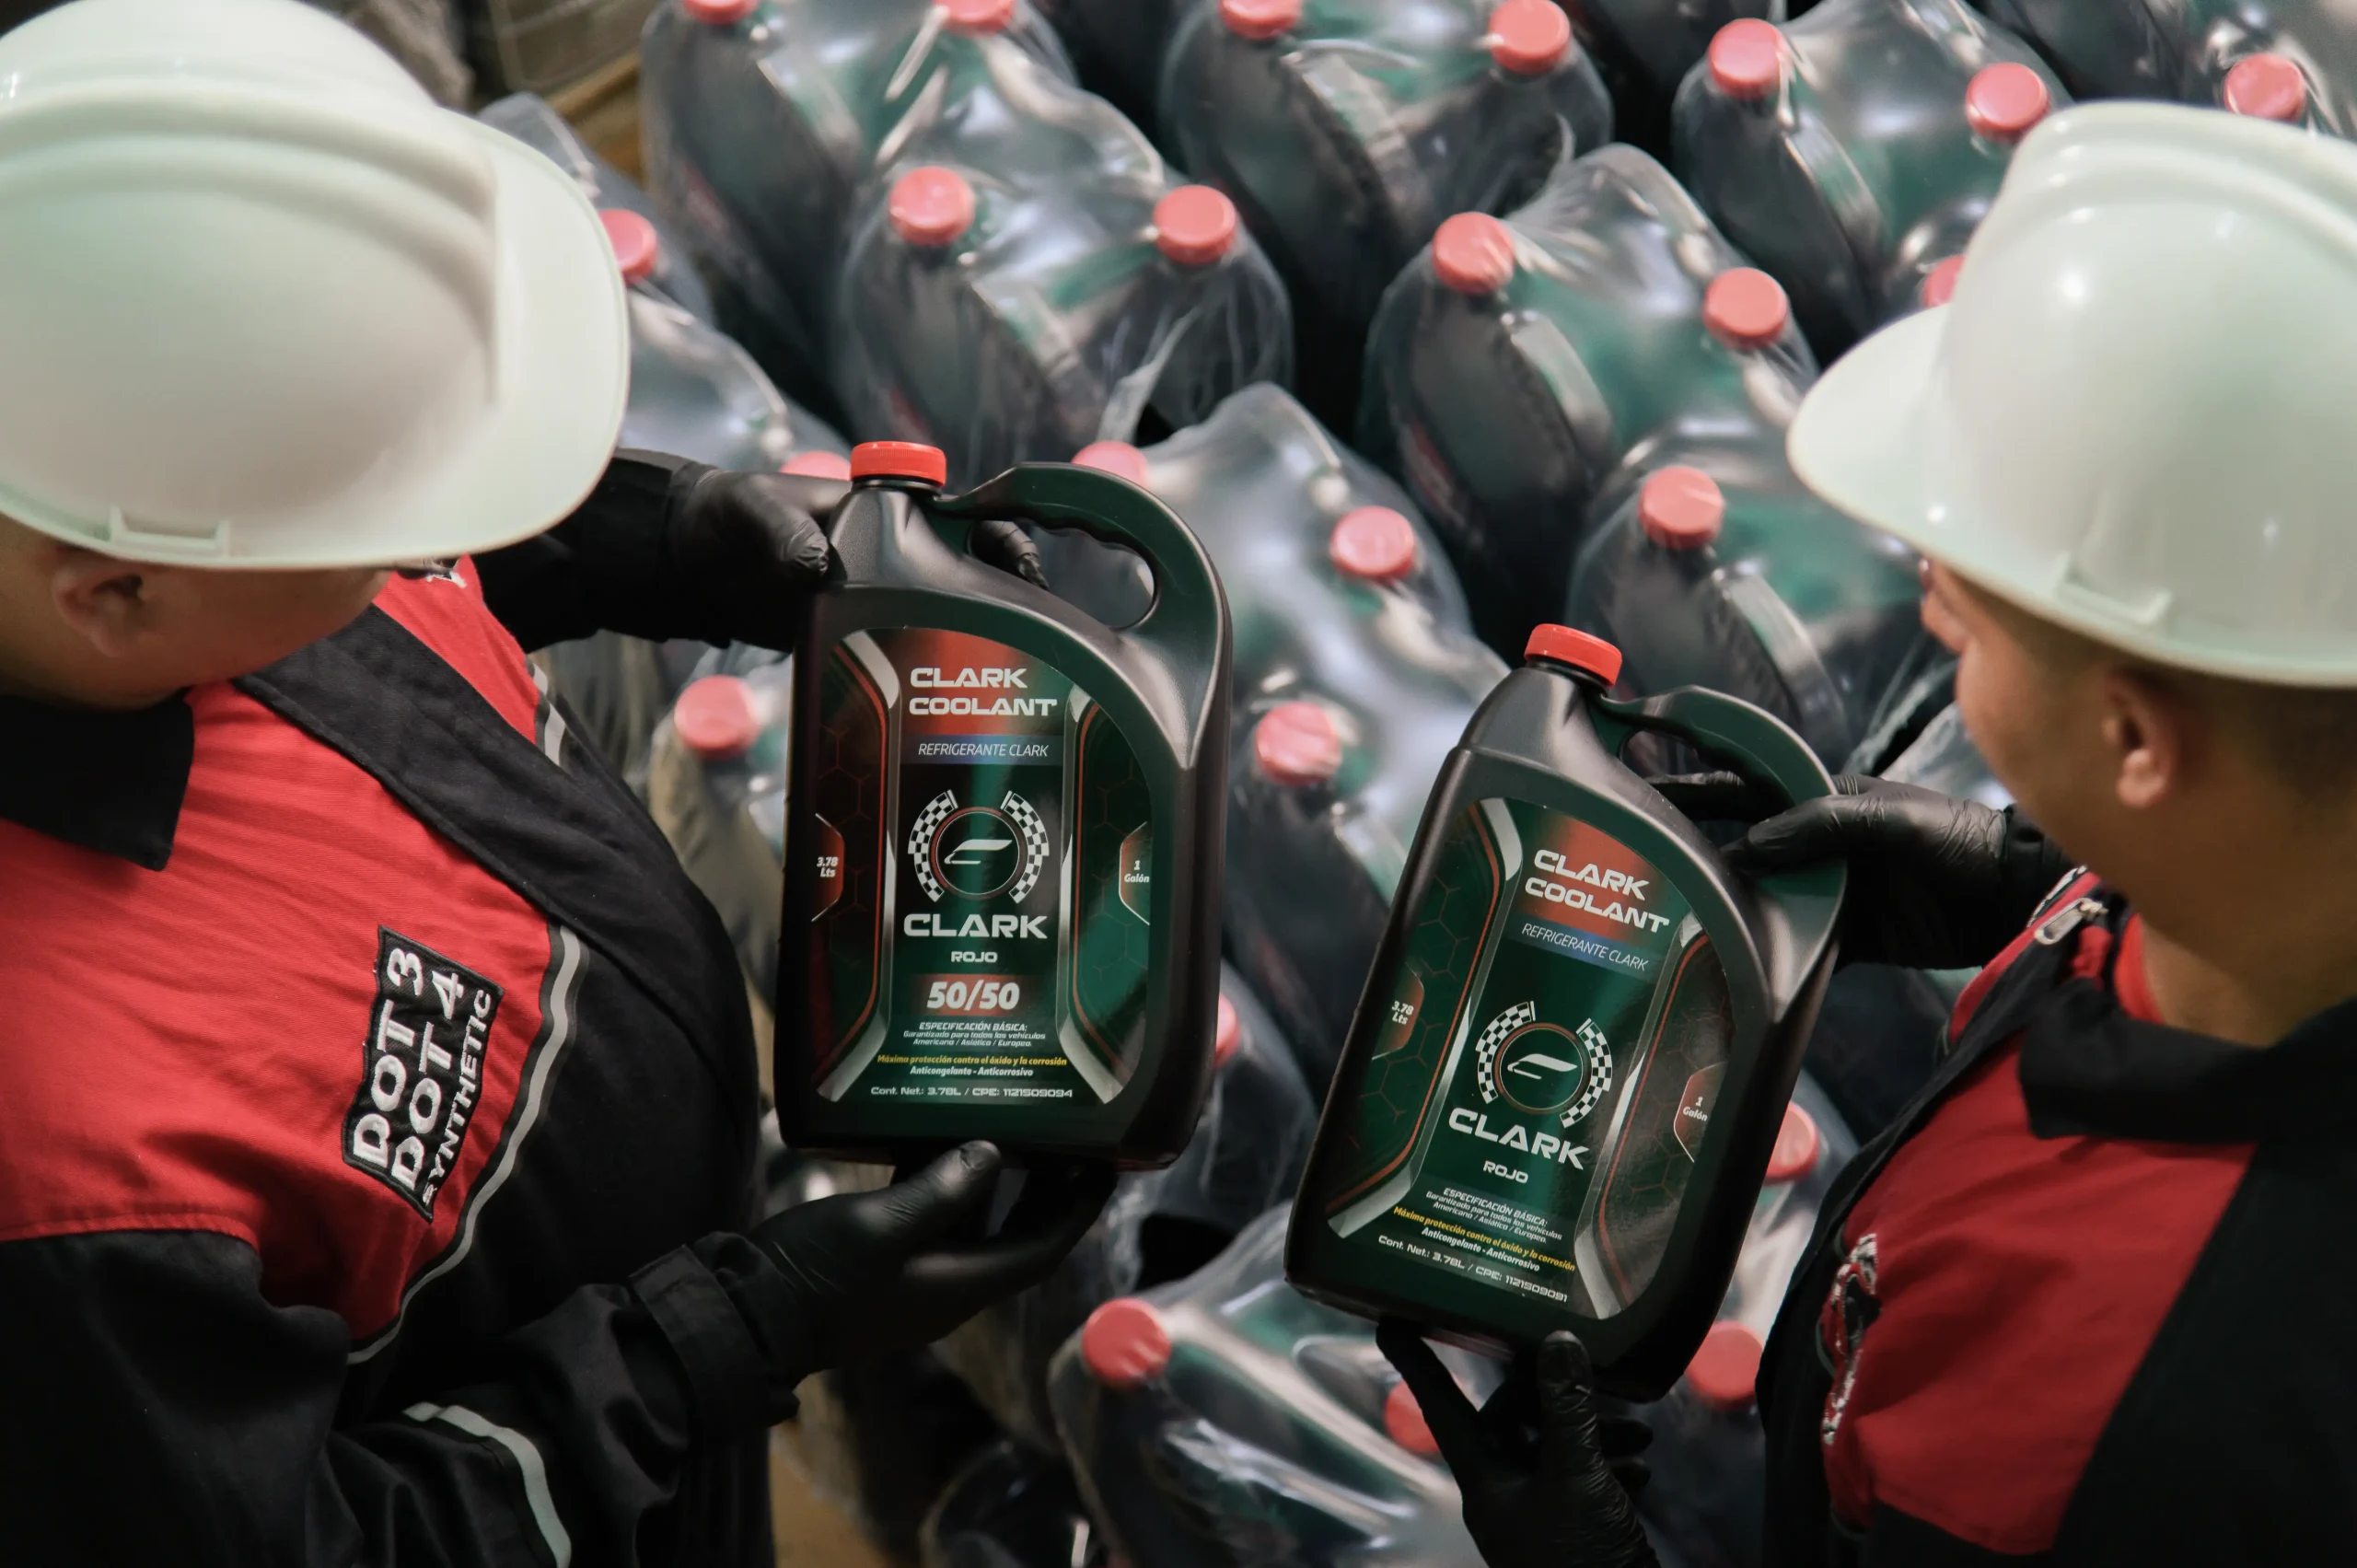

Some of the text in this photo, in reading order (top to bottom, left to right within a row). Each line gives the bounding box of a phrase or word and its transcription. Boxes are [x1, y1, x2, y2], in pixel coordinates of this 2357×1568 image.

[910, 668, 1028, 689] CLARK
[909, 697, 1058, 716] COOLANT
[918, 743, 1050, 758] REFRIGERANTE CLARK
[817, 856, 839, 867] 3.78
[1133, 860, 1141, 870] 1
[819, 867, 836, 877] Lts
[1124, 873, 1150, 883] Galón
[1534, 849, 1650, 900] CLARK
[1525, 877, 1669, 934] COOLANT
[903, 913, 1048, 939] CLARK
[1521, 923, 1650, 971] REFRIGERANTE CLARK
[950, 950, 998, 963] ROJO
[926, 980, 1020, 1011] 50/50
[1391, 1000, 1414, 1016] 3.78
[919, 1020, 1028, 1032] ESPECIFICACIÓN BÁSICA:
[1391, 1011, 1409, 1025] Lts
[903, 1030, 949, 1039] Garantizado
[950, 1031, 969, 1040] para
[970, 1031, 993, 1040] todos
[994, 1031, 1006, 1040] los
[913, 1038, 954, 1046] Americano
[353, 947, 424, 1168] DOT 3
[877, 1054, 1067, 1066] Máxima protección contra el óxido y la corrosión
[910, 1065, 971, 1077] Anticongelante
[977, 1066, 1034, 1076] Anticorrosivo
[390, 970, 464, 1191] DOT 4
[422, 989, 491, 1206] SYNTHETIC
[870, 1086, 898, 1096] Cont.
[927, 1087, 961, 1096] 3.78L
[972, 1087, 1000, 1097] CPE:
[1695, 1096, 1703, 1108] 1
[1682, 1106, 1708, 1121] Galón
[1449, 1107, 1589, 1170] CLARK
[1482, 1160, 1528, 1184] ROJO
[1425, 1191, 1471, 1211] Garantizado
[1470, 1204, 1490, 1216] para
[1490, 1211, 1512, 1224] todos
[1513, 1218, 1525, 1228] los
[1433, 1202, 1473, 1220] Americano
[1443, 1187, 1548, 1227] ESPECIFICACIÓN BÁSICA:
[1393, 1205, 1576, 1272] Máxima protección contra el óxido y la corrosión
[1421, 1226, 1481, 1252] Anticongelante
[1486, 1247, 1540, 1272] Anticorrosivo
[1378, 1235, 1404, 1249] Cont.
[1432, 1251, 1465, 1269] 3.78L
[1475, 1265, 1503, 1282] CPE:
